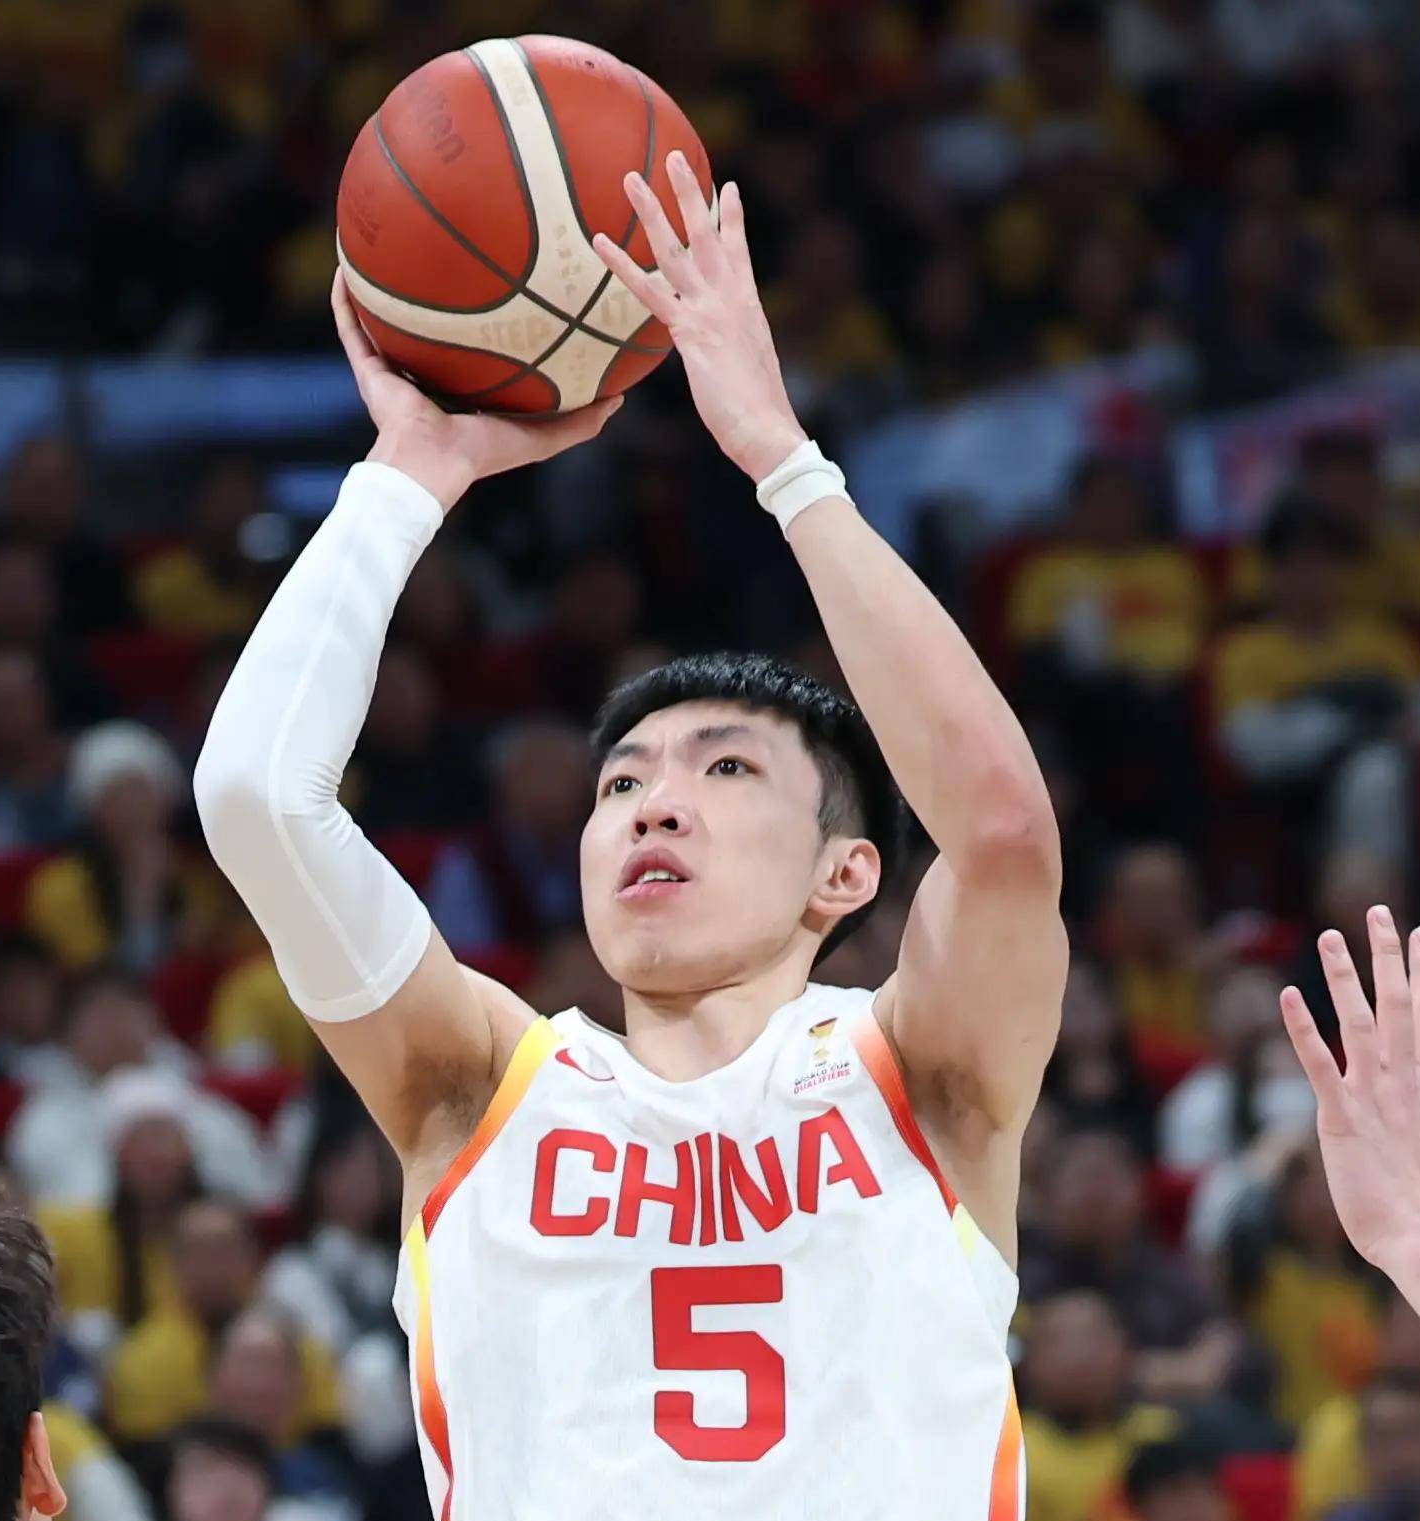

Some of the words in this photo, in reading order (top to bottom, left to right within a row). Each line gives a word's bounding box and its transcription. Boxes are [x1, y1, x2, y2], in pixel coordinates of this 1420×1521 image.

[793, 1068, 851, 1096] QUALIFIERS
[529, 1106, 883, 1247] CHINA
[651, 1263, 786, 1462] 5
